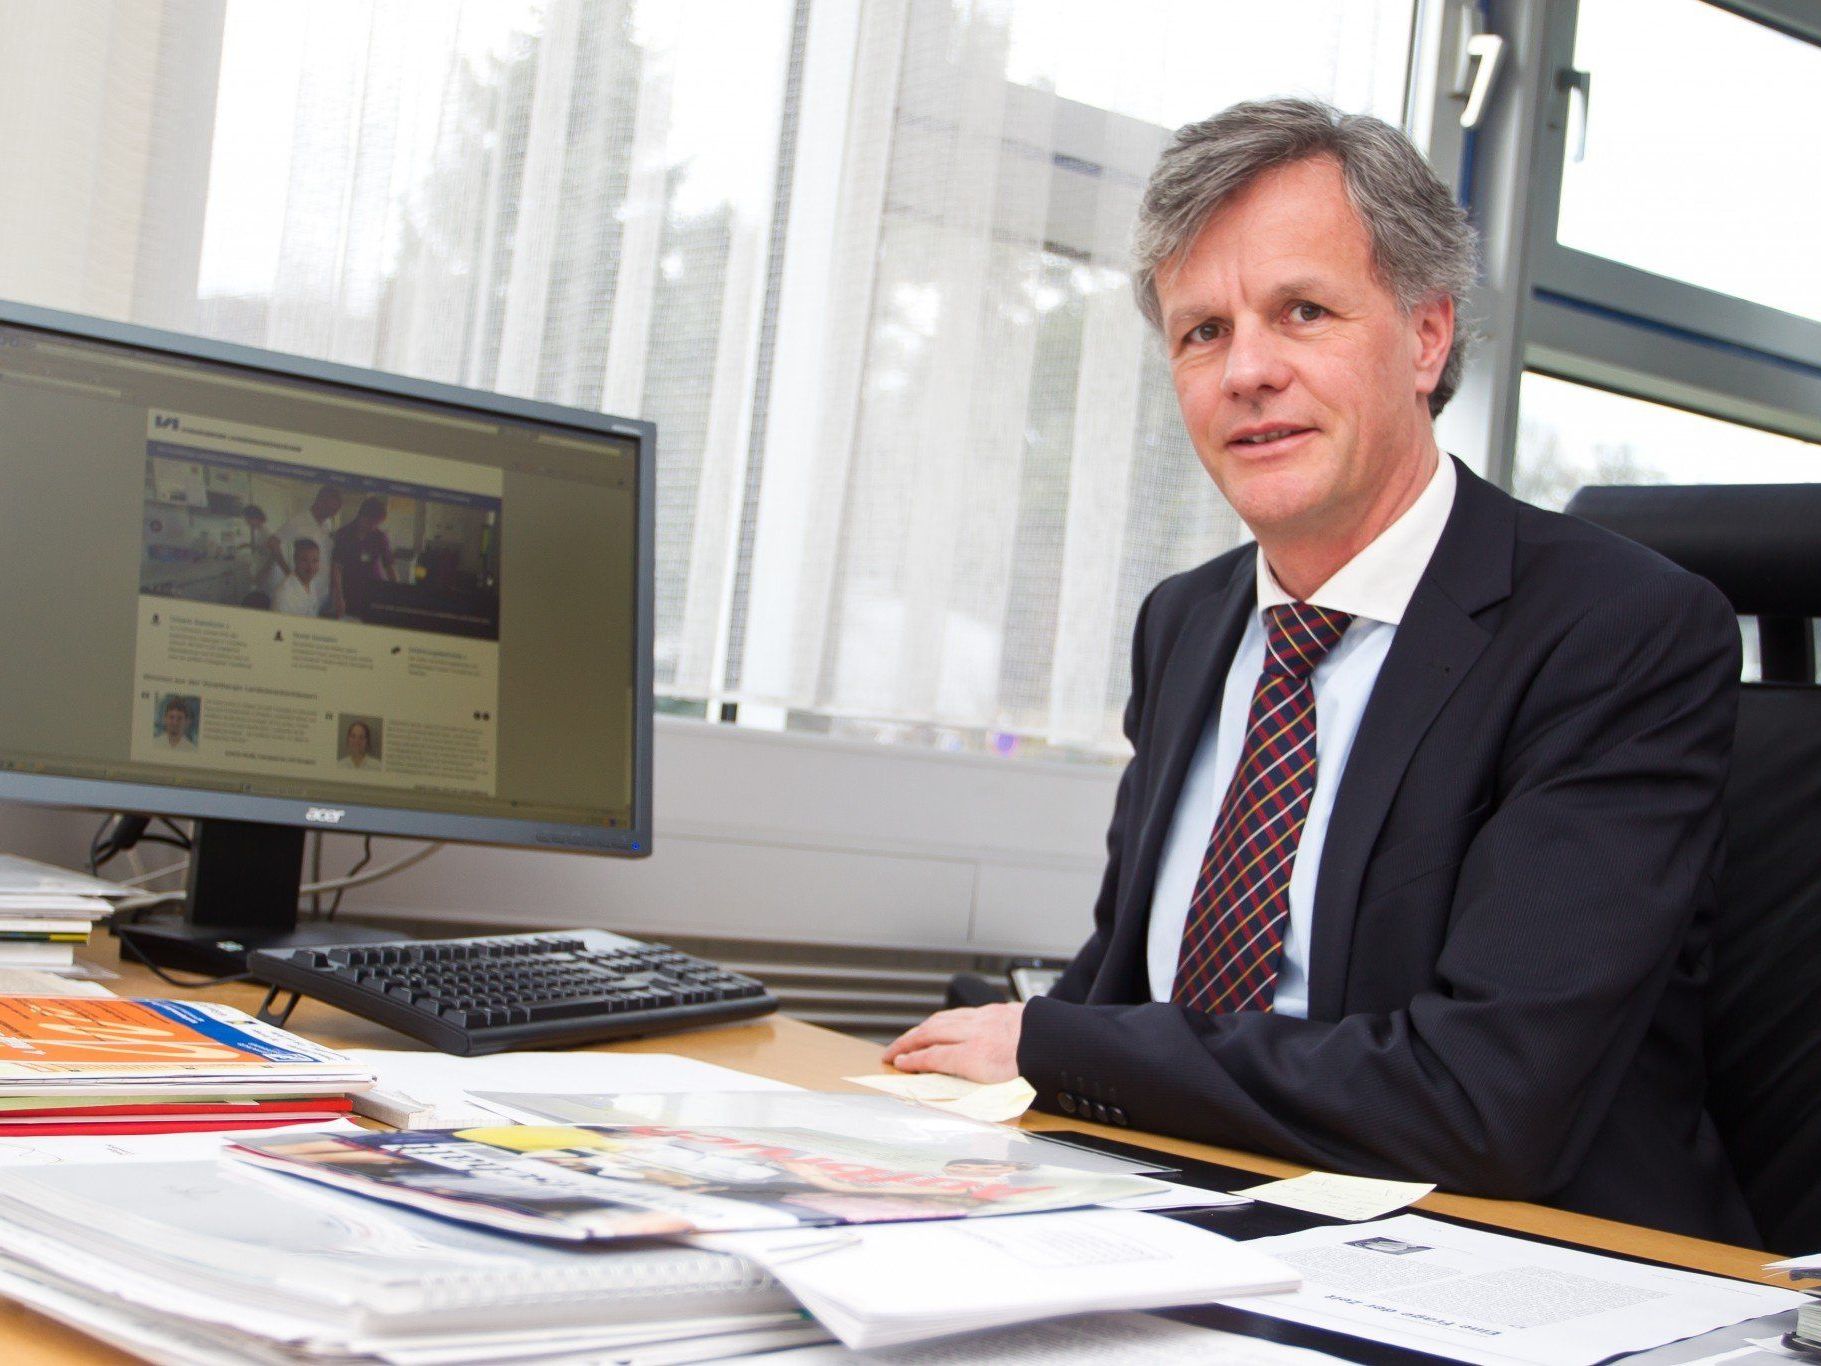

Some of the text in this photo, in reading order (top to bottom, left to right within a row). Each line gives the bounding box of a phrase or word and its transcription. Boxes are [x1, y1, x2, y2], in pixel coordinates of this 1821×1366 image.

[305, 807, 345, 824] acer
[1324, 1294, 1502, 1336] Eine Frage der Zeit
